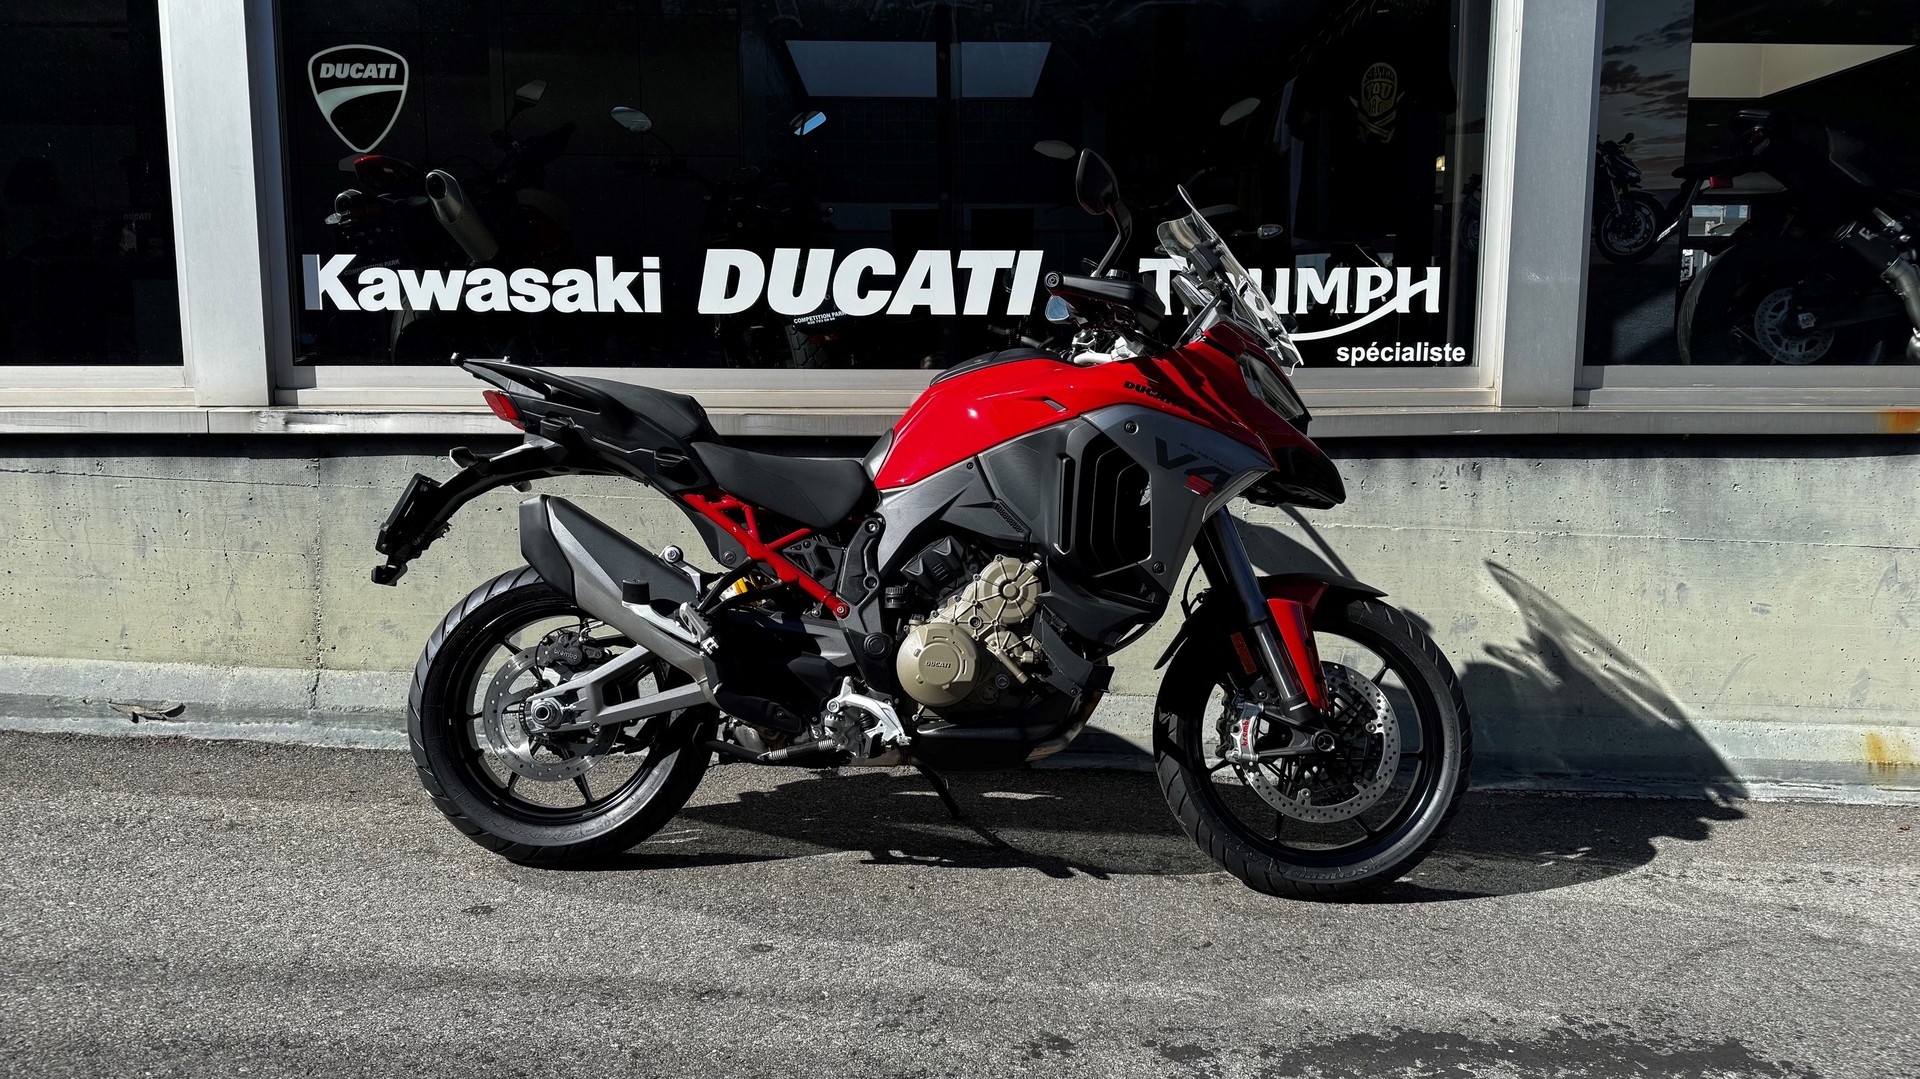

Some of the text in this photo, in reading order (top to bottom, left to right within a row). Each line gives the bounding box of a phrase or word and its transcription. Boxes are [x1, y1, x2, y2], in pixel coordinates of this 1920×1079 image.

[319, 63, 397, 79] DUCATI
[303, 254, 662, 313] Kawasaki
[698, 248, 1044, 316] DUCATI
[1139, 257, 1440, 339] TUMPH
[793, 313, 831, 324] COMPETITION
[1336, 342, 1466, 366] spécialiste
[1179, 442, 1235, 473] MULTISTRADA
[554, 648, 579, 660] brembo
[925, 660, 952, 669] DUCATI
[1241, 716, 1251, 748] brembo
